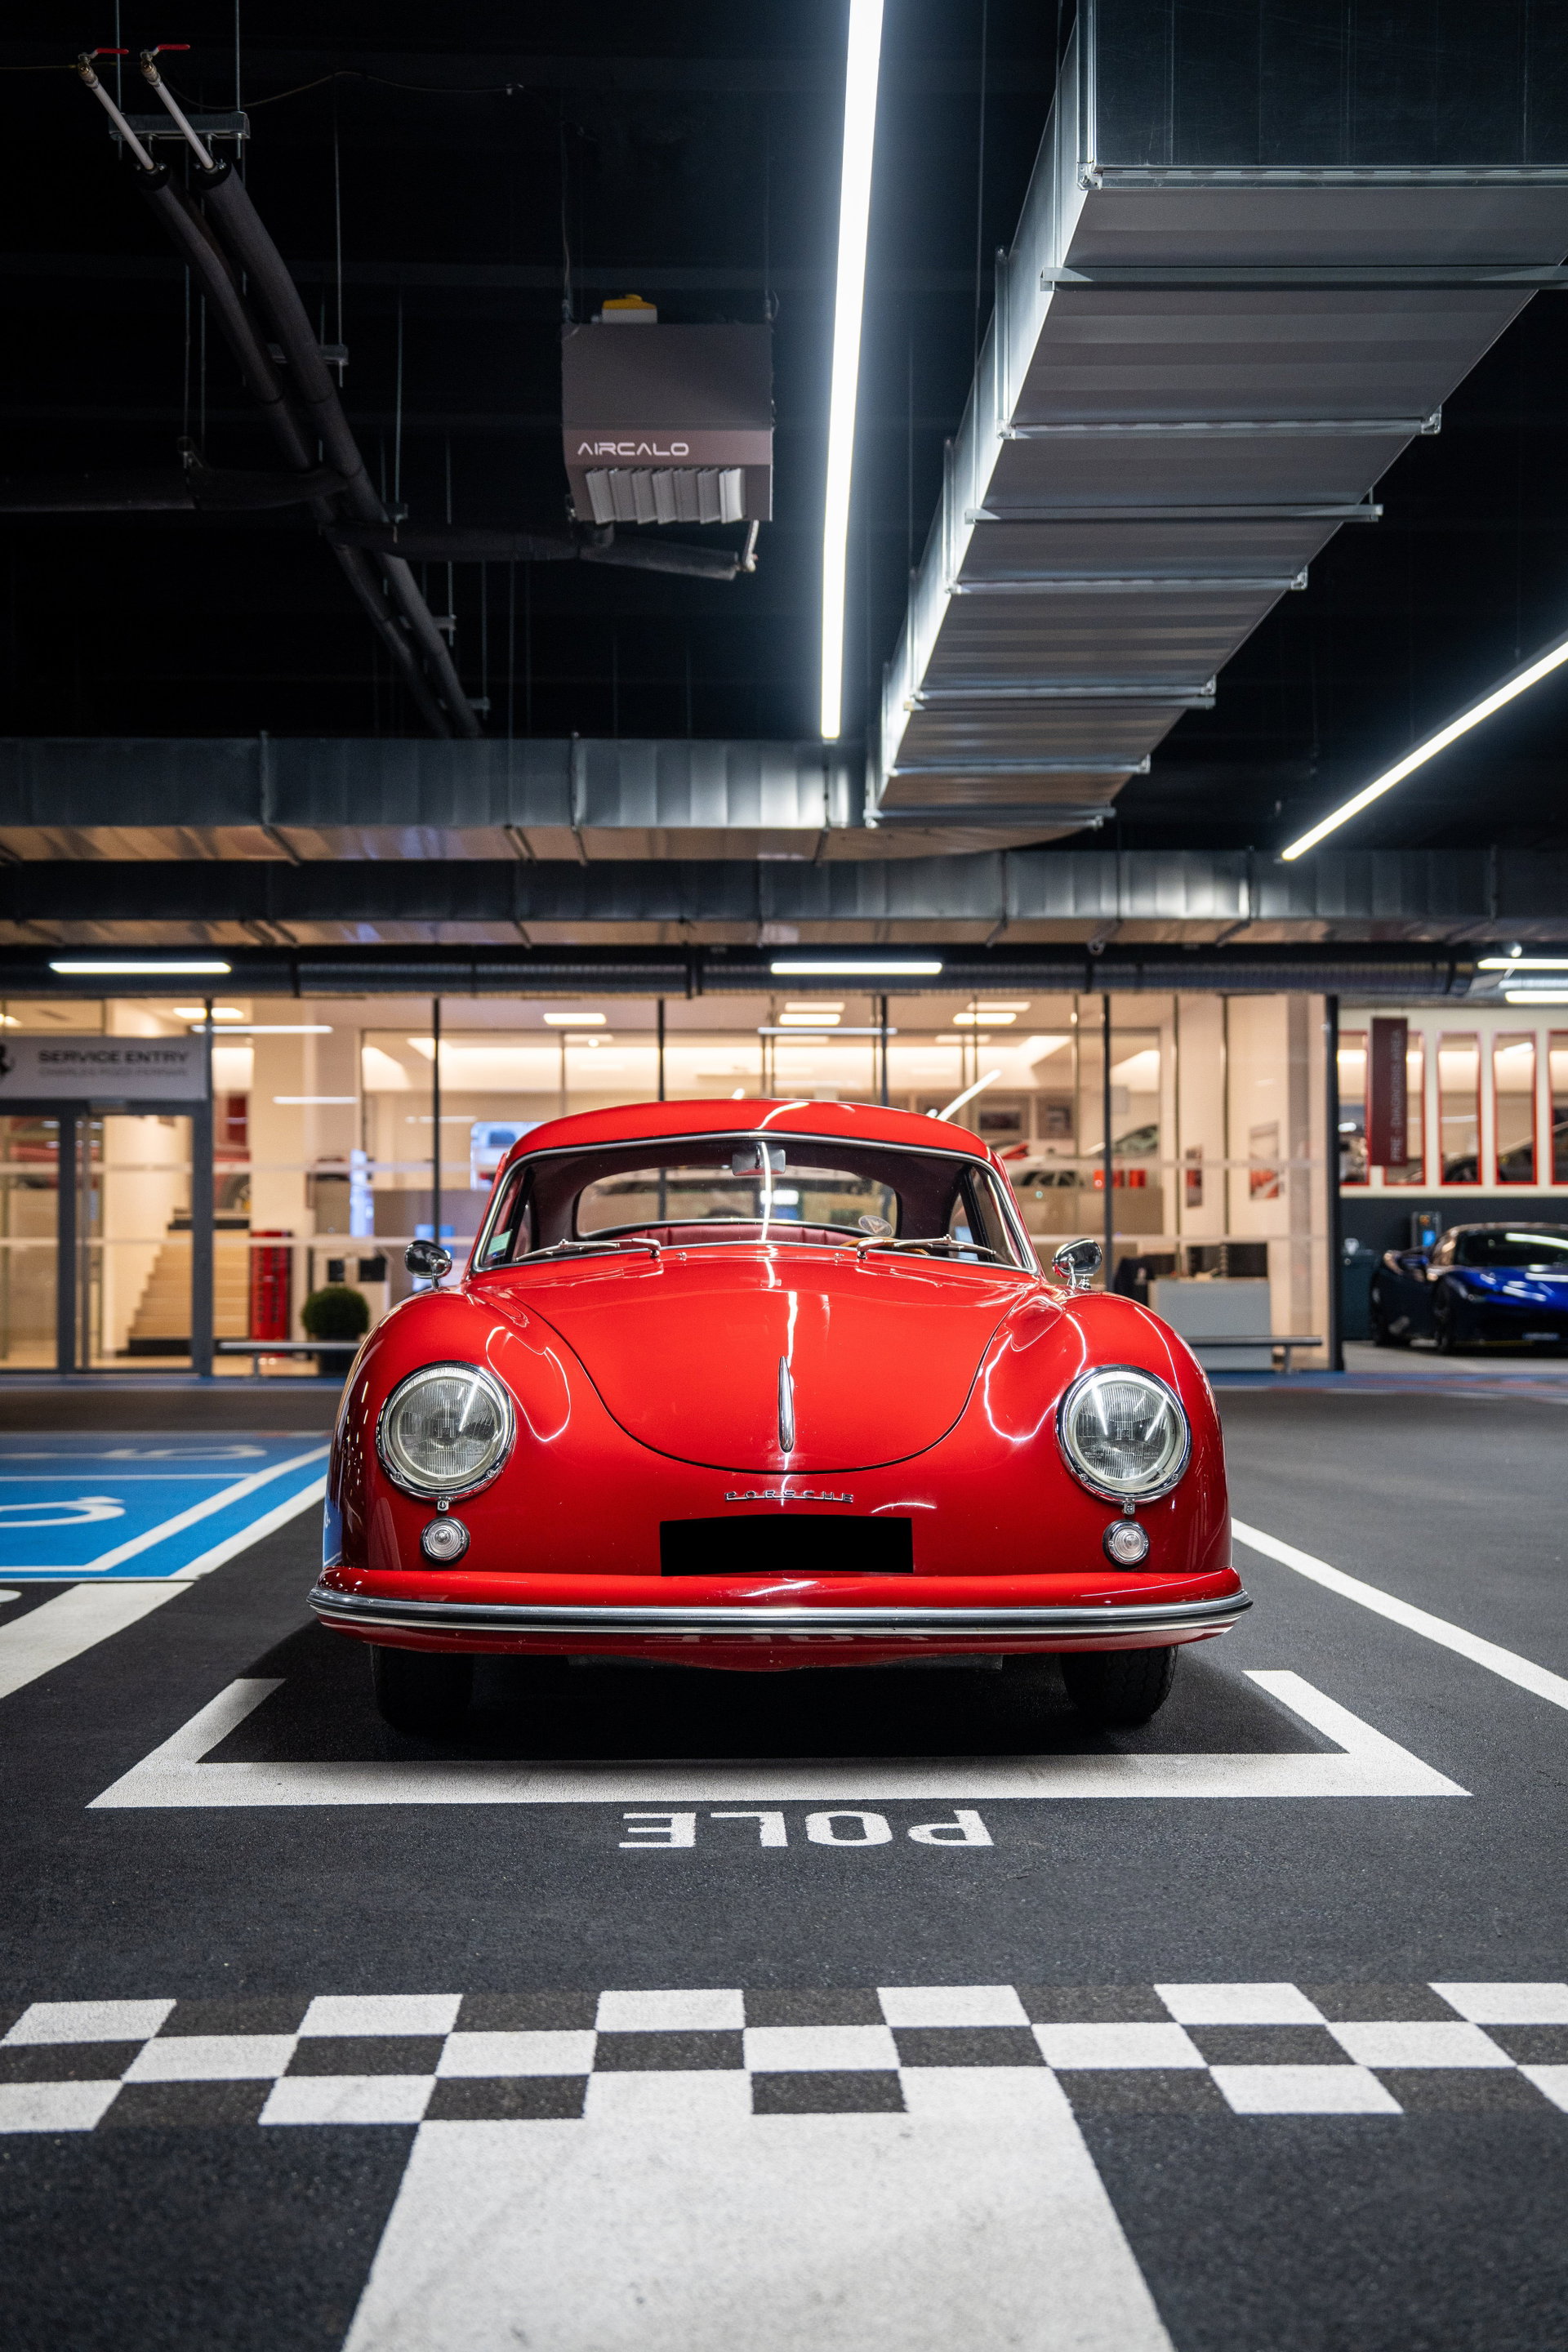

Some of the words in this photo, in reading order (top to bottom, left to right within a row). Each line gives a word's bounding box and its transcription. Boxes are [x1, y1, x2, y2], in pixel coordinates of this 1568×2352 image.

[577, 442, 689, 456] AIRCALO
[39, 1049, 120, 1062] SERVICE
[125, 1049, 188, 1062] ENTRY
[724, 1490, 854, 1503] PORSCHE
[619, 1810, 995, 1848] POLE
